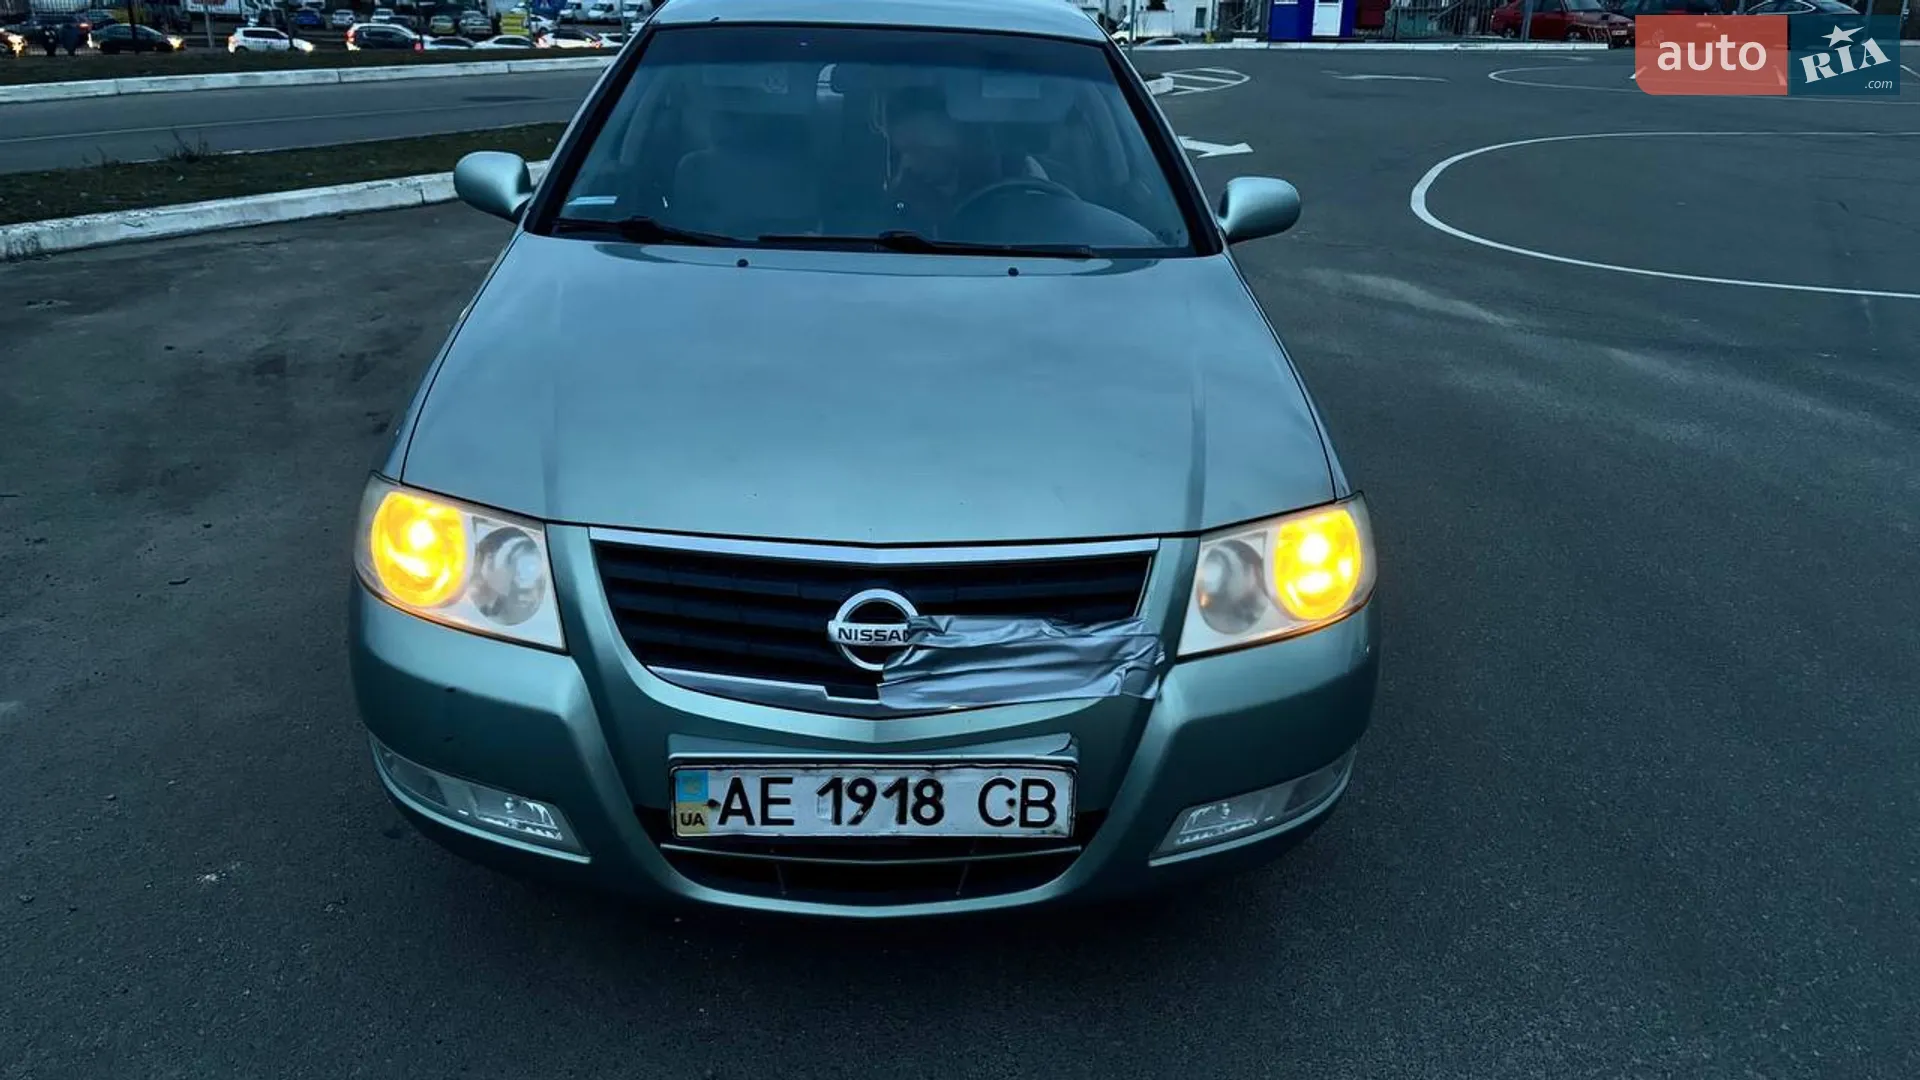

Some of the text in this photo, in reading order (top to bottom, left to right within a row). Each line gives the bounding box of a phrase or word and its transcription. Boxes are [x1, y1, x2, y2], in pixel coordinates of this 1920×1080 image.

[718, 777, 1057, 827] AE 1918 CB
[681, 813, 705, 826] UA
